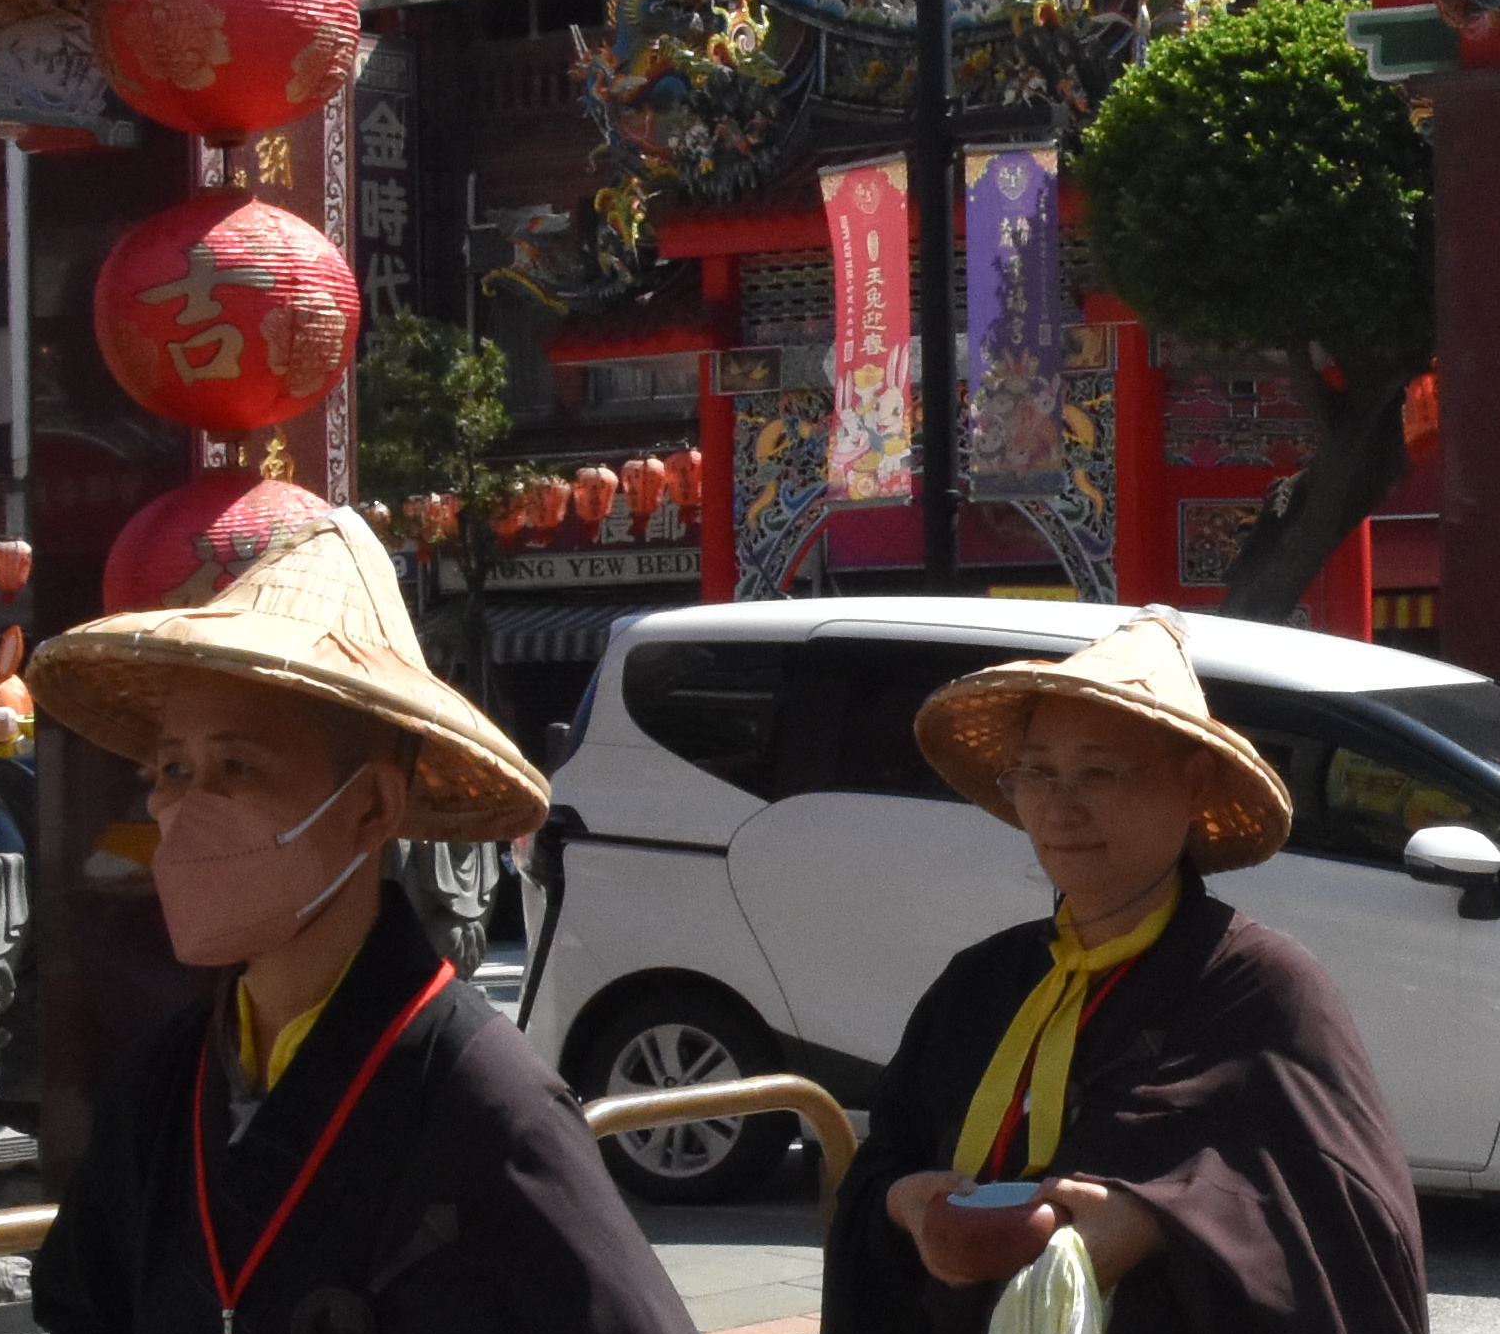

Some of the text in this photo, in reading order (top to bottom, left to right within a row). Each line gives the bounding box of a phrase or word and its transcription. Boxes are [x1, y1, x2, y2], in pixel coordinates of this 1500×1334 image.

[360, 100, 410, 339] 金時代
[135, 241, 277, 387] 吉
[566, 556, 626, 577] YEW
